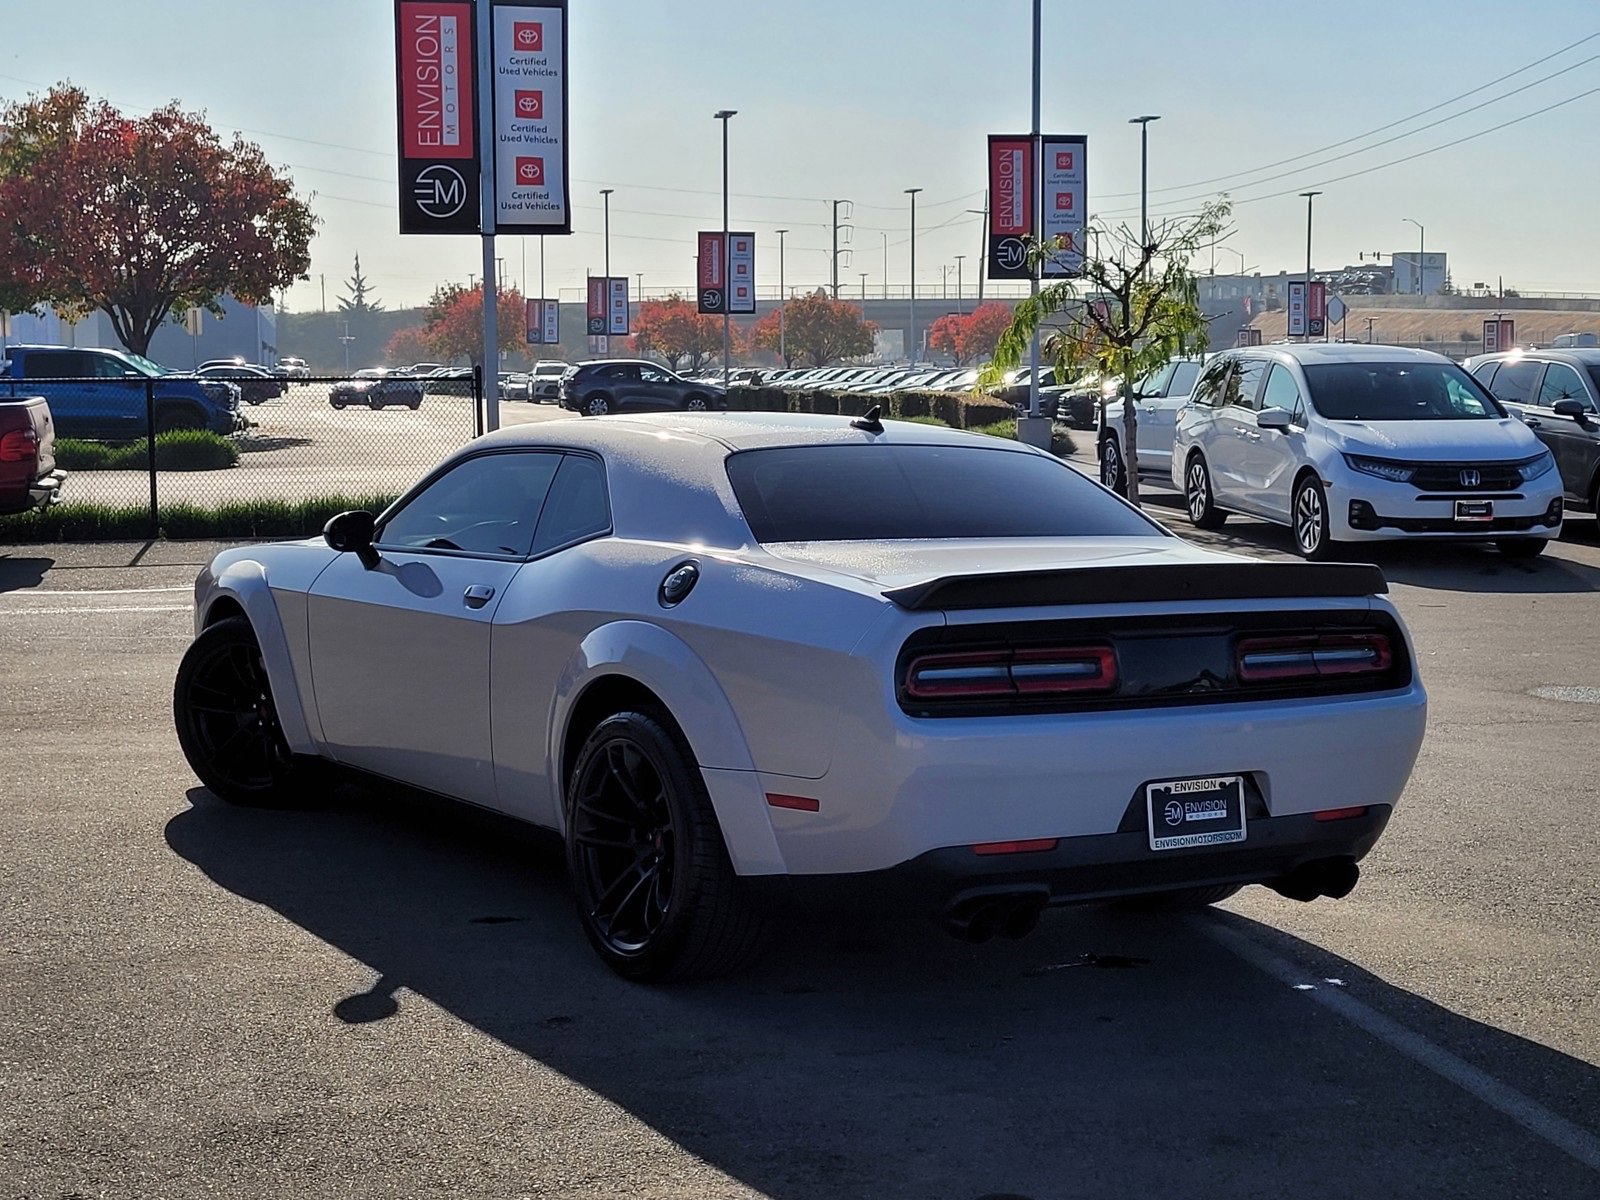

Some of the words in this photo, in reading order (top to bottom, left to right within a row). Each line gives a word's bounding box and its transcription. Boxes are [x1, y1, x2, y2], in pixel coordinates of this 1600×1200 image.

[509, 57, 547, 66] Certified
[499, 67, 520, 76] Used
[523, 68, 558, 77] Vehicles
[415, 15, 440, 146] ENVISION
[444, 28, 456, 134] MOTORS
[510, 124, 547, 133] Certified
[500, 134, 521, 142] Used
[524, 135, 558, 144] Vehicles
[1000, 150, 1012, 227] ENVISION
[511, 192, 549, 200] Certified
[501, 202, 523, 210] Used
[525, 202, 560, 210] Vehicles
[1174, 780, 1217, 792] ENVISION
[1185, 800, 1226, 812] ENVISION
